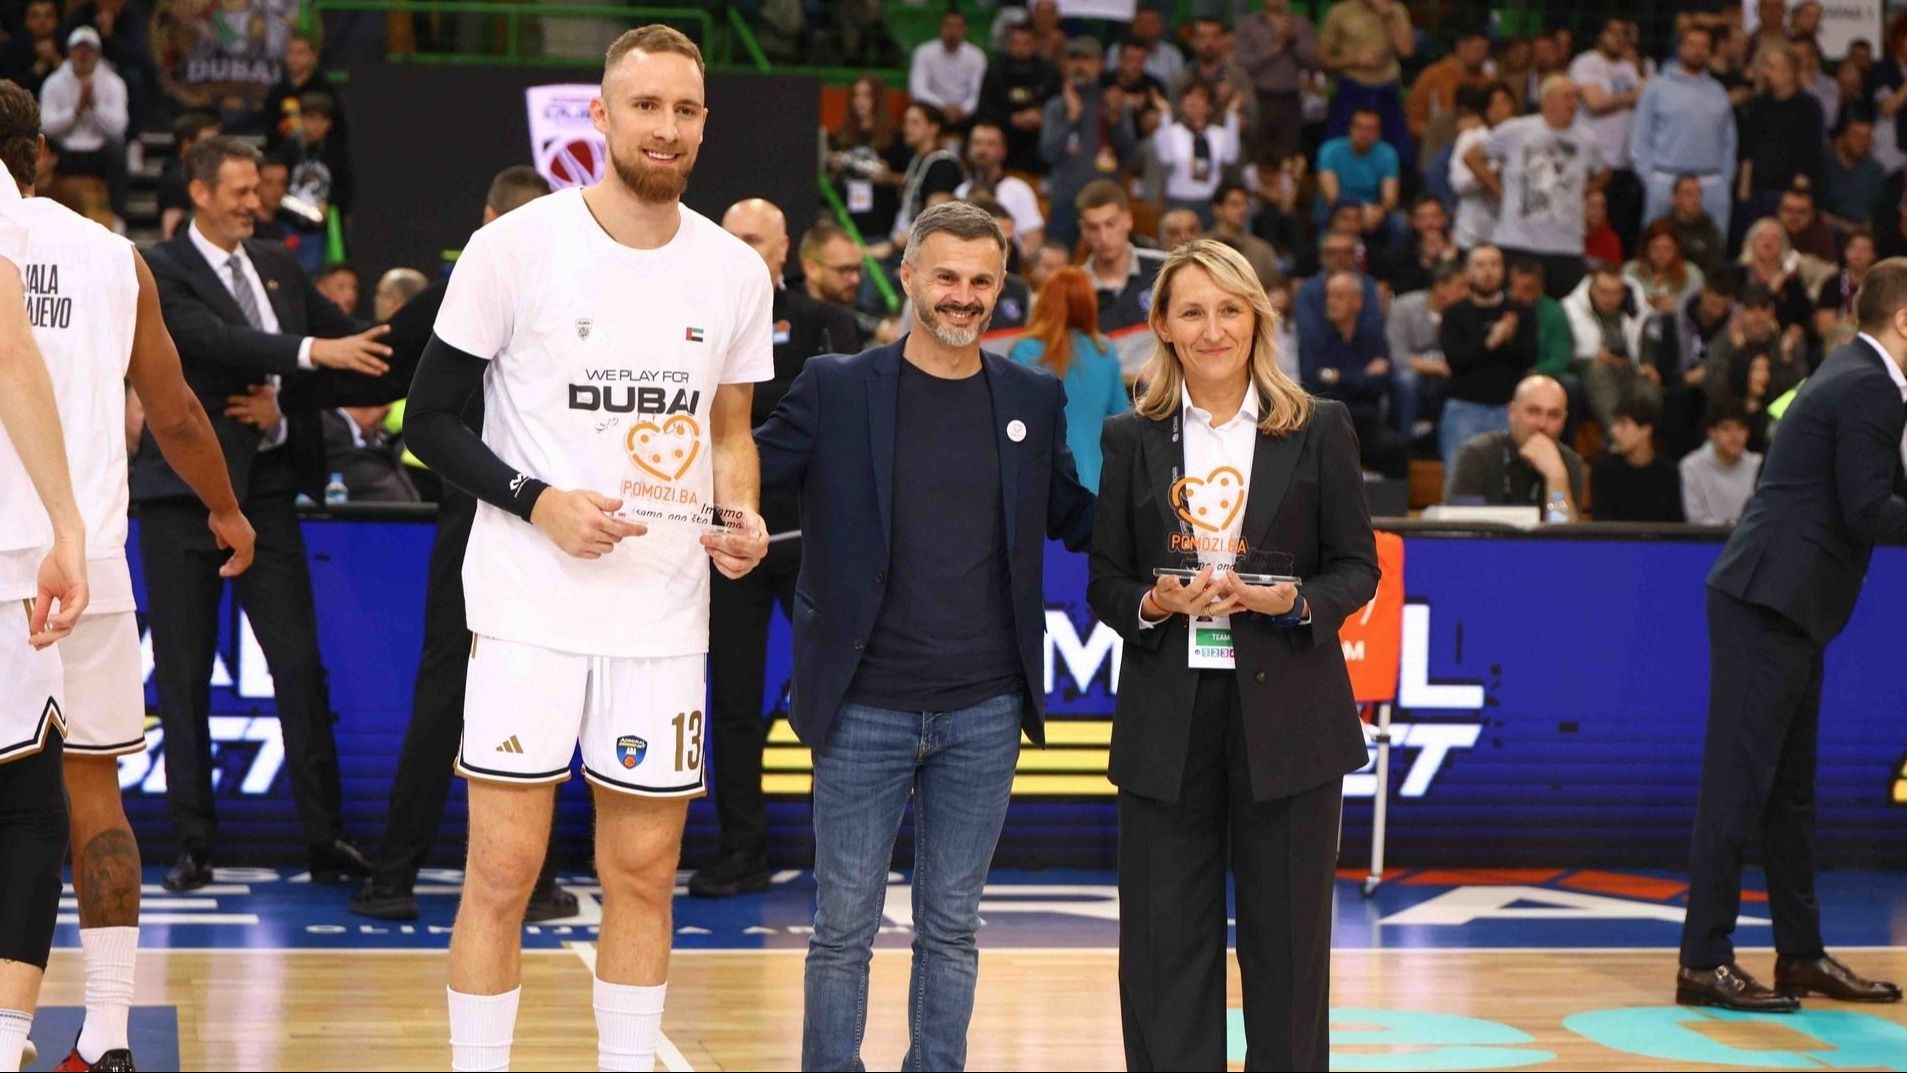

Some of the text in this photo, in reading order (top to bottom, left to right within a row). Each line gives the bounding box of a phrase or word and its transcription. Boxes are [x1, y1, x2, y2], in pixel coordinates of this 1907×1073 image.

[26, 295, 72, 329] AJEVO
[585, 368, 689, 384] WE PLAY FOR
[568, 383, 700, 416] DUBAI
[622, 480, 698, 505] POMOZI.BA
[701, 503, 743, 519] Imamo
[1171, 534, 1247, 554] POMOZI.BA
[1211, 633, 1231, 641] TEAM
[671, 710, 702, 772] 13
